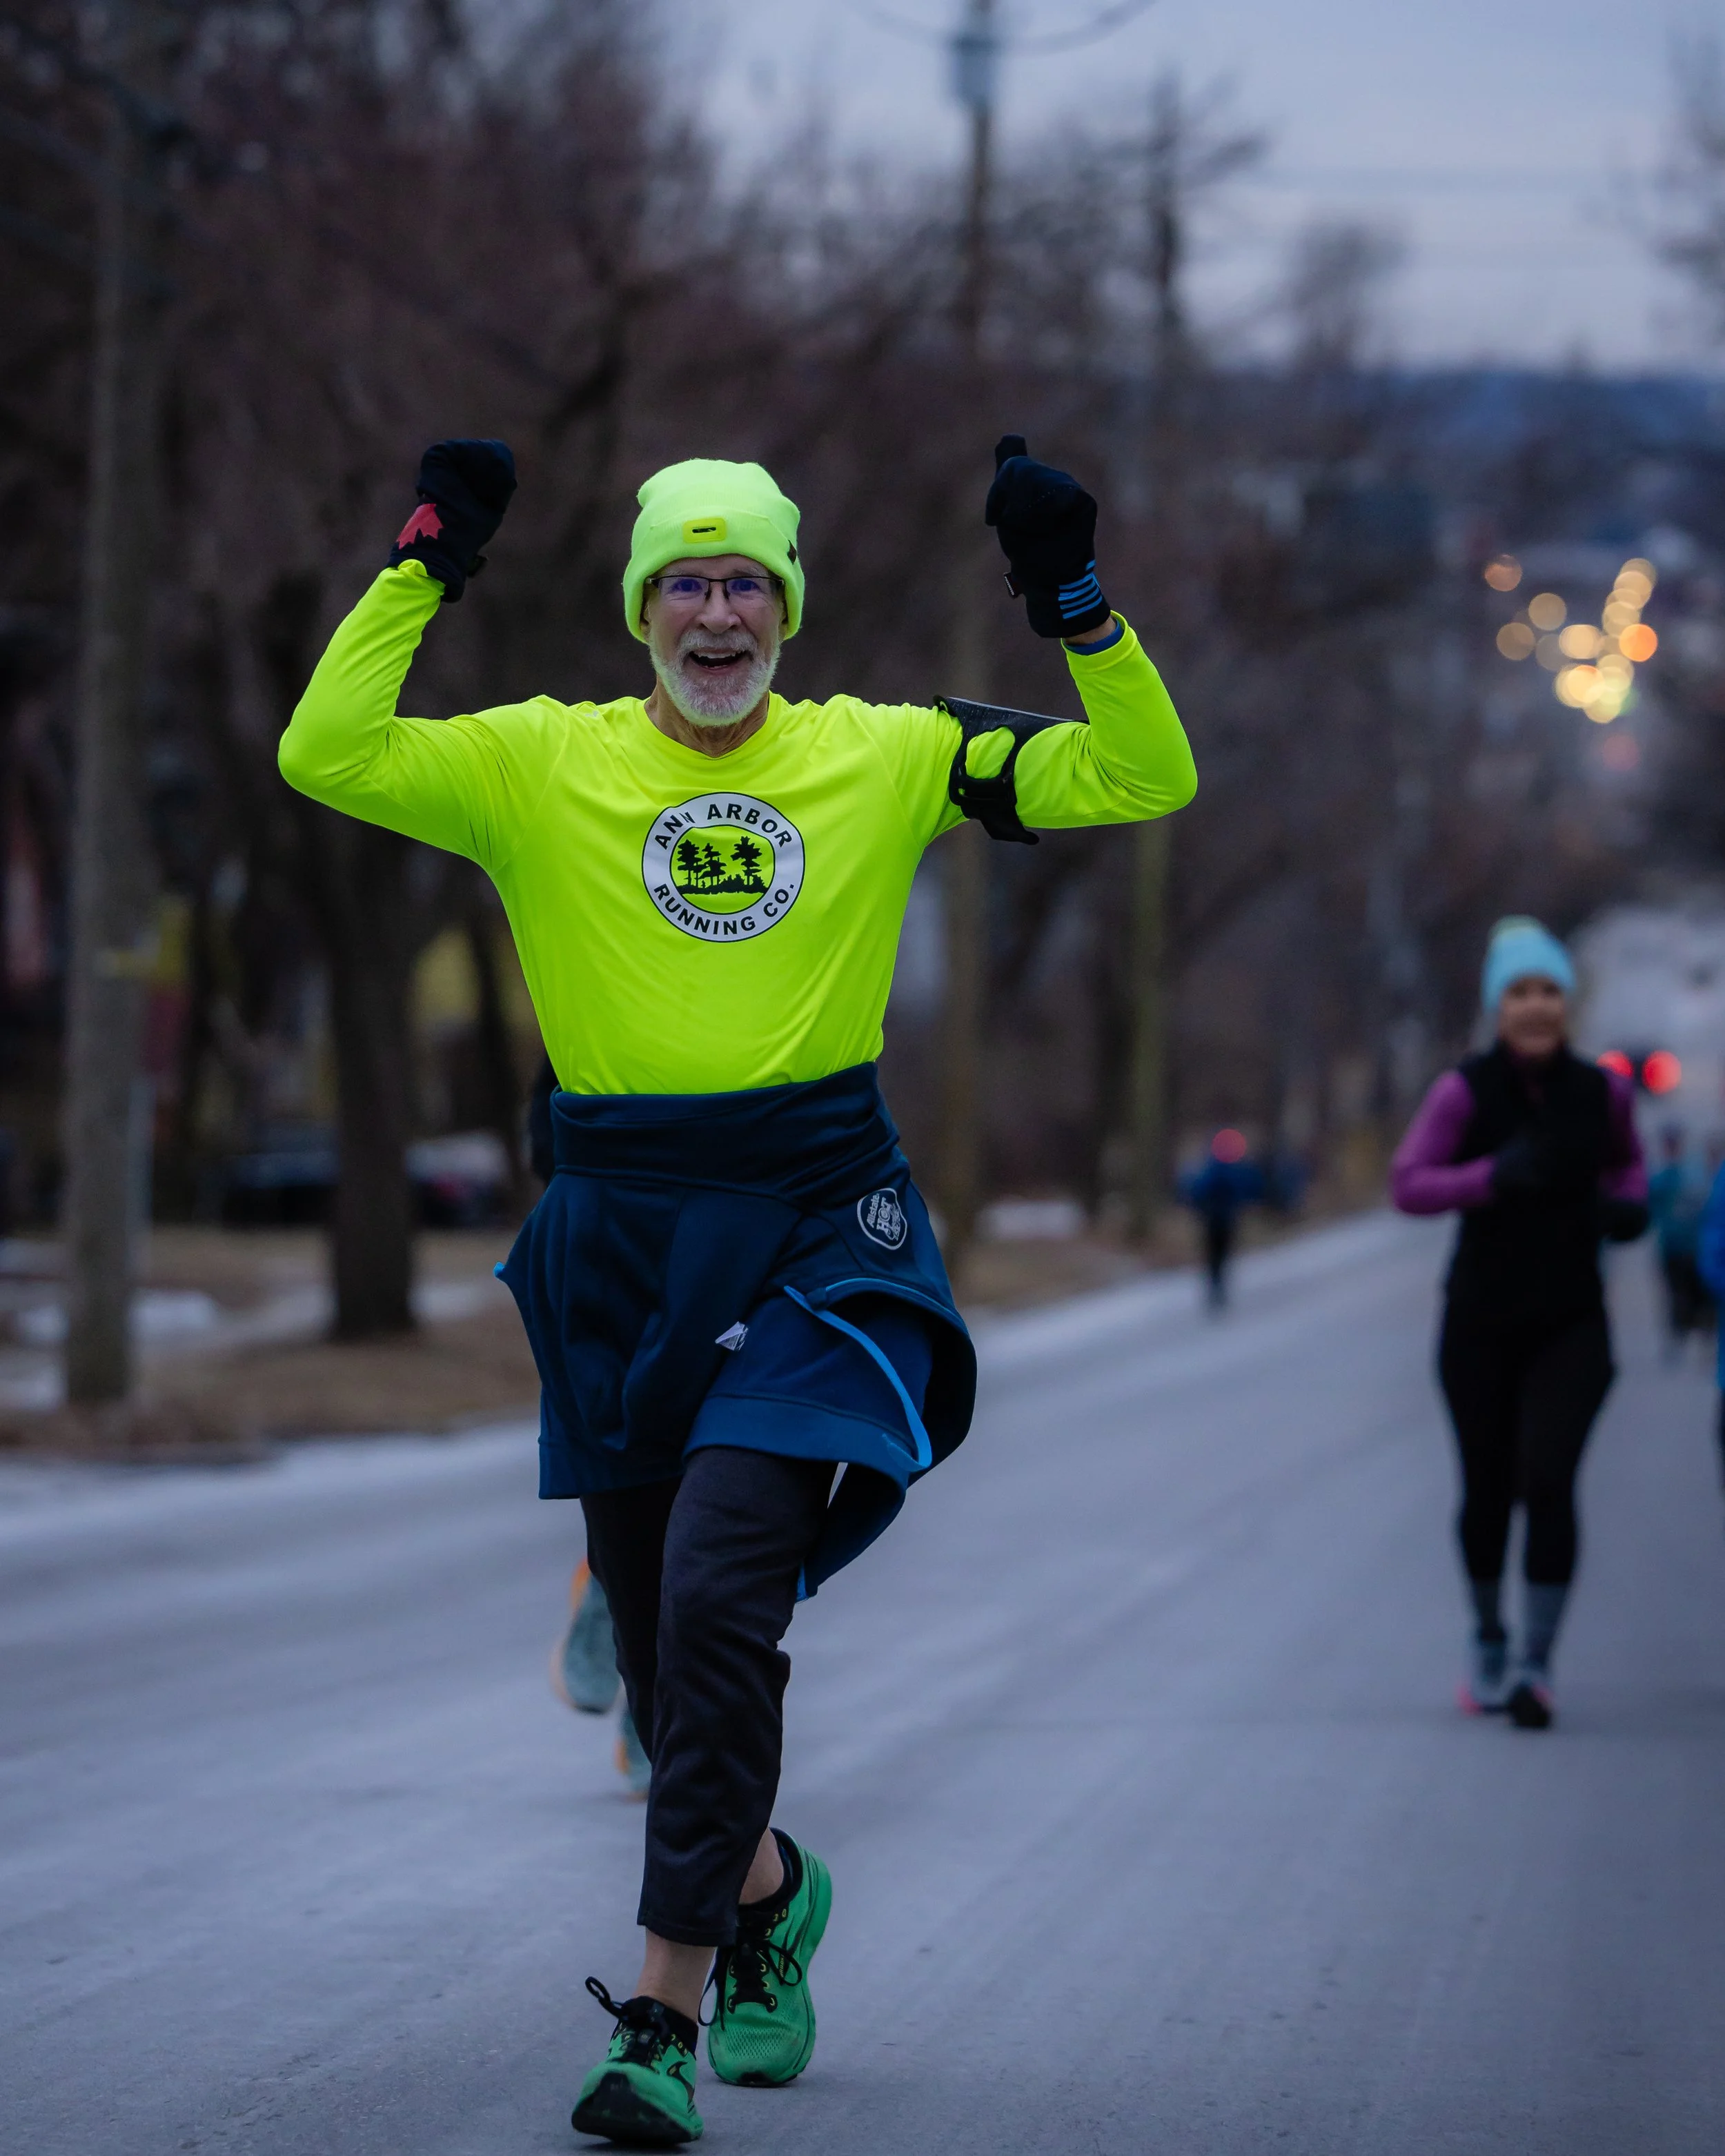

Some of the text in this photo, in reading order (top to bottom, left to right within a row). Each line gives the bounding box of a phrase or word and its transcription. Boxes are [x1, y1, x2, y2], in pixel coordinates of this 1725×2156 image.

[655, 803, 792, 849] ANN ARBOR
[653, 883, 794, 935] RUNNING CO.
